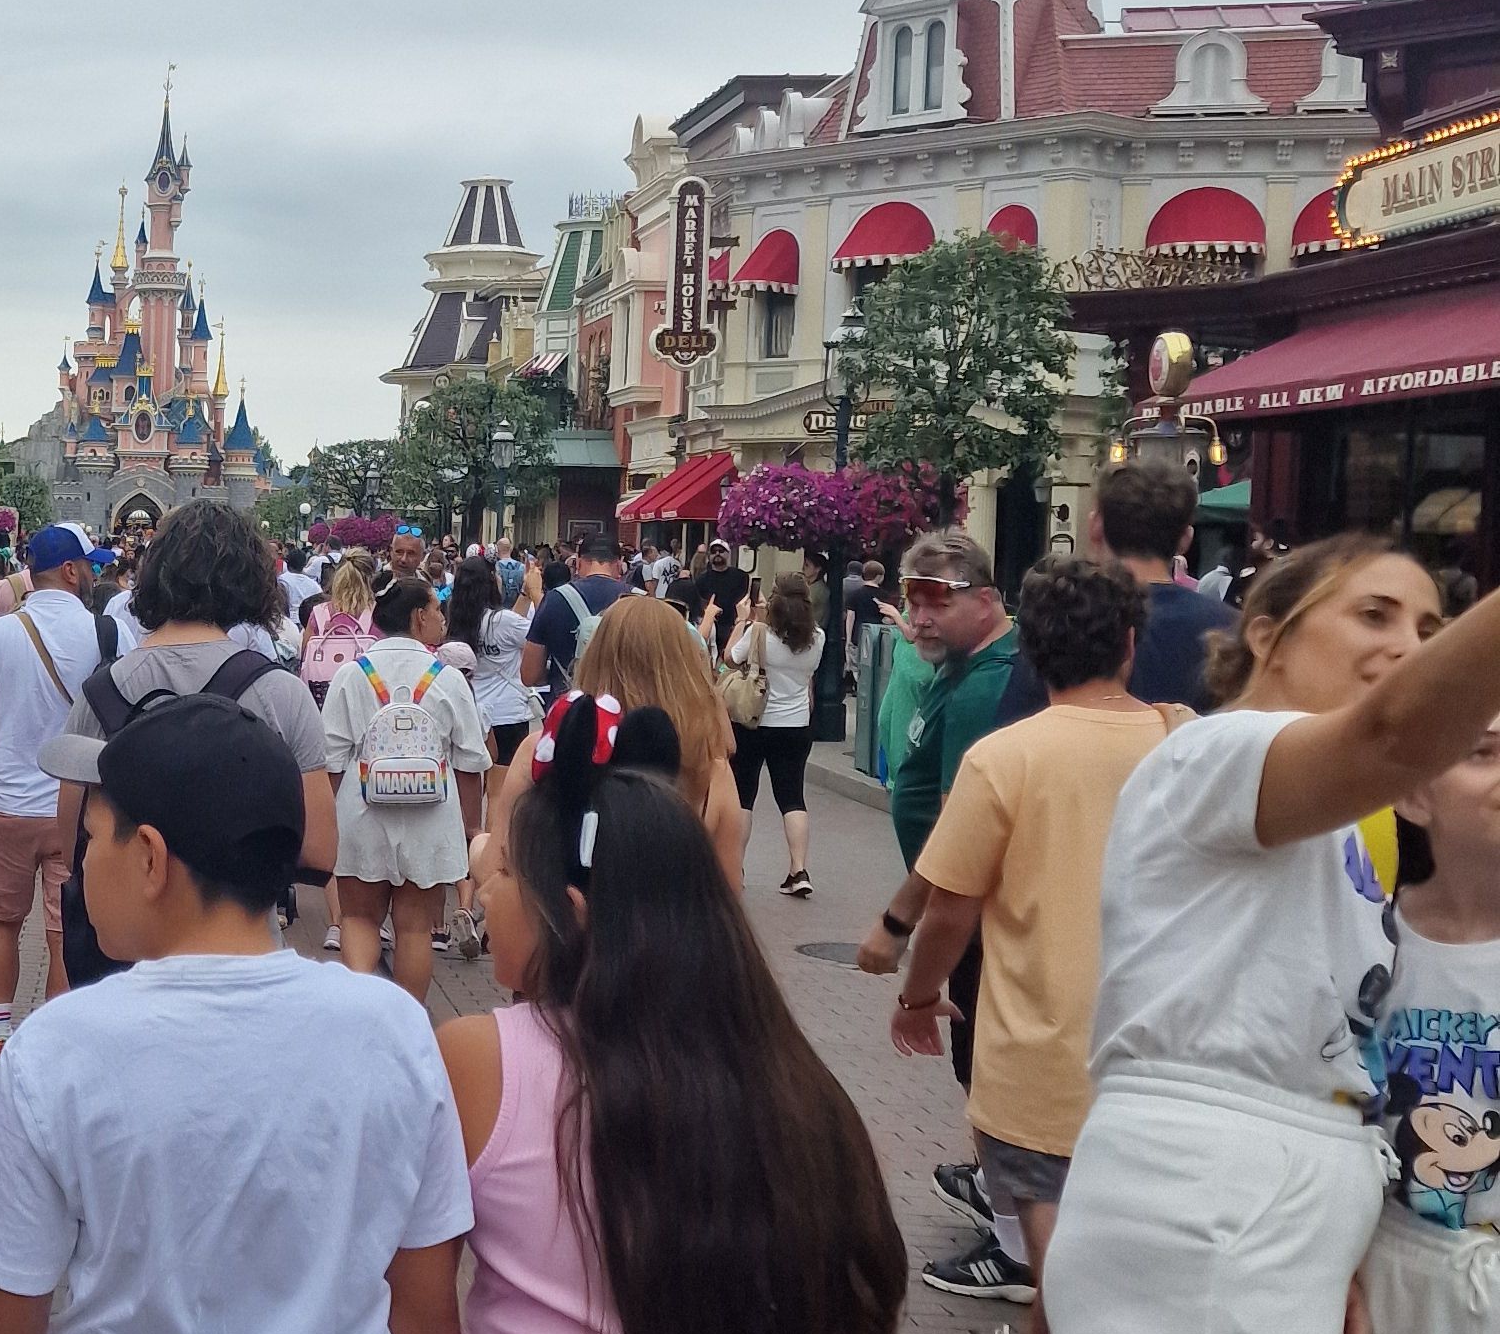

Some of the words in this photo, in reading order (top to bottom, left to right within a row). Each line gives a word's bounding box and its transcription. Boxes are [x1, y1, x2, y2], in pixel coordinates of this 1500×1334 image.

[1381, 161, 1443, 215] MAIN
[1451, 143, 1500, 197] STR
[683, 194, 700, 267] MARKET
[681, 273, 695, 333] HOUSE
[664, 335, 708, 348] DELI
[1141, 396, 1244, 417] DENDABLE
[1258, 392, 1290, 409] ALL
[1298, 383, 1345, 405] NEW
[376, 771, 434, 794] MARVEL
